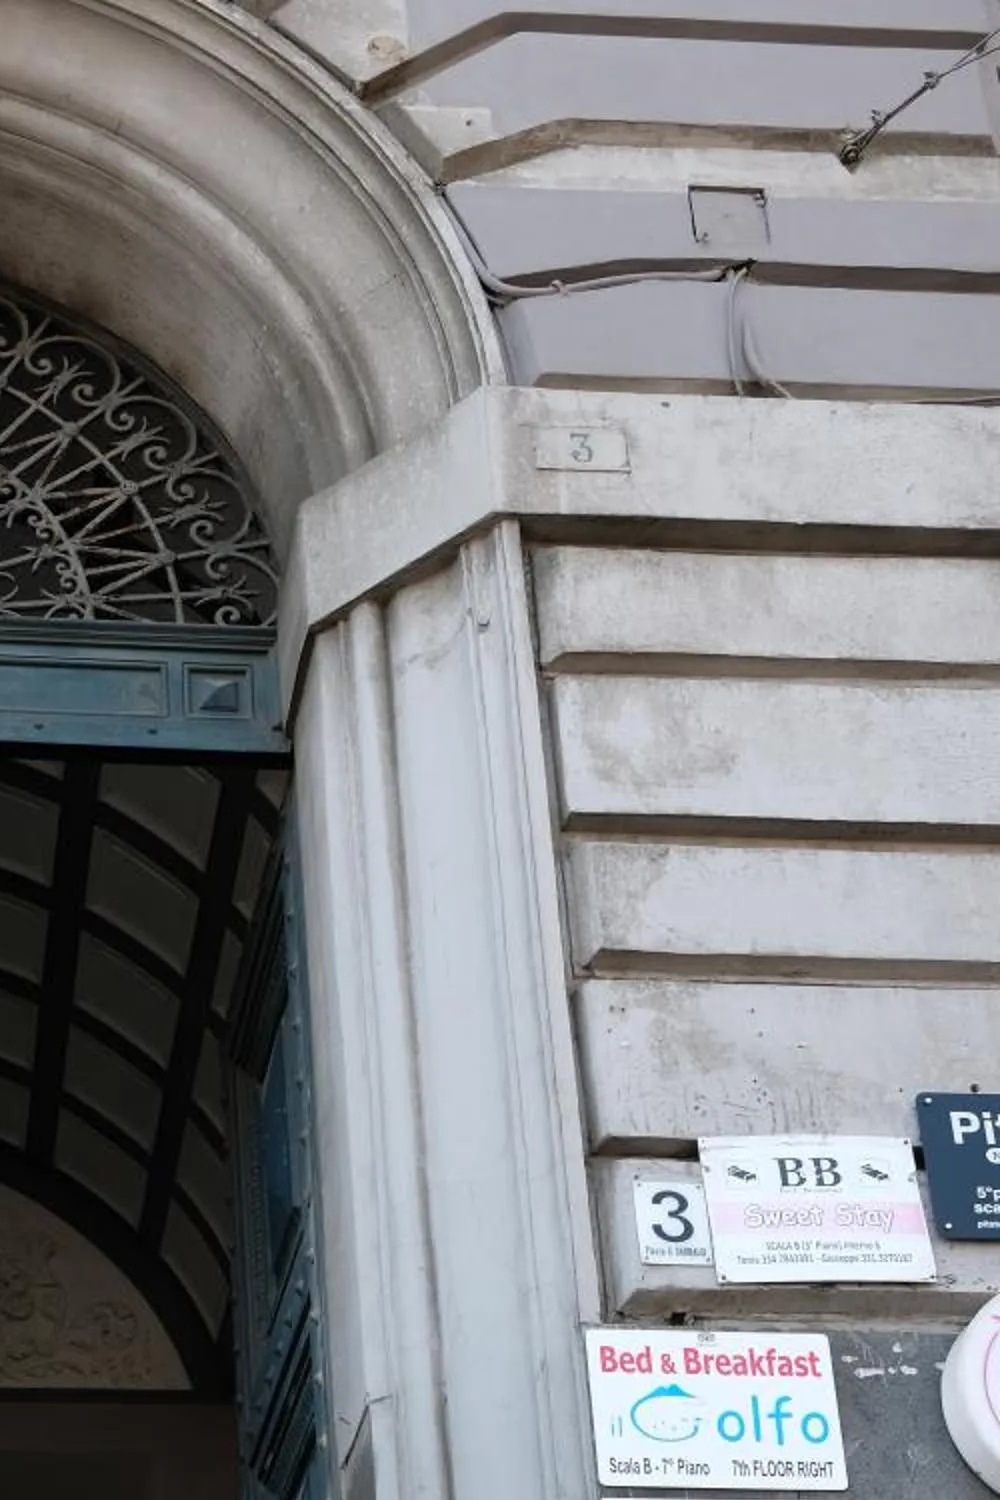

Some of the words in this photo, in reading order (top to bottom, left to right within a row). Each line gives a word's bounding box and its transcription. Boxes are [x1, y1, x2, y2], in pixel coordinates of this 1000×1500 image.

[569, 433, 594, 463] 3
[950, 1111, 1000, 1145] Pi
[651, 1190, 694, 1242] 3
[744, 1203, 824, 1228] Sweet
[835, 1203, 894, 1234] Stay
[600, 1345, 652, 1374] Bed
[660, 1353, 677, 1375] &
[683, 1347, 823, 1378] Breakfast
[609, 1457, 641, 1475] Scala
[643, 1458, 653, 1474] B
[677, 1459, 711, 1476] Piano
[753, 1460, 793, 1478] FLOOR
[797, 1461, 834, 1478] RIGHT
